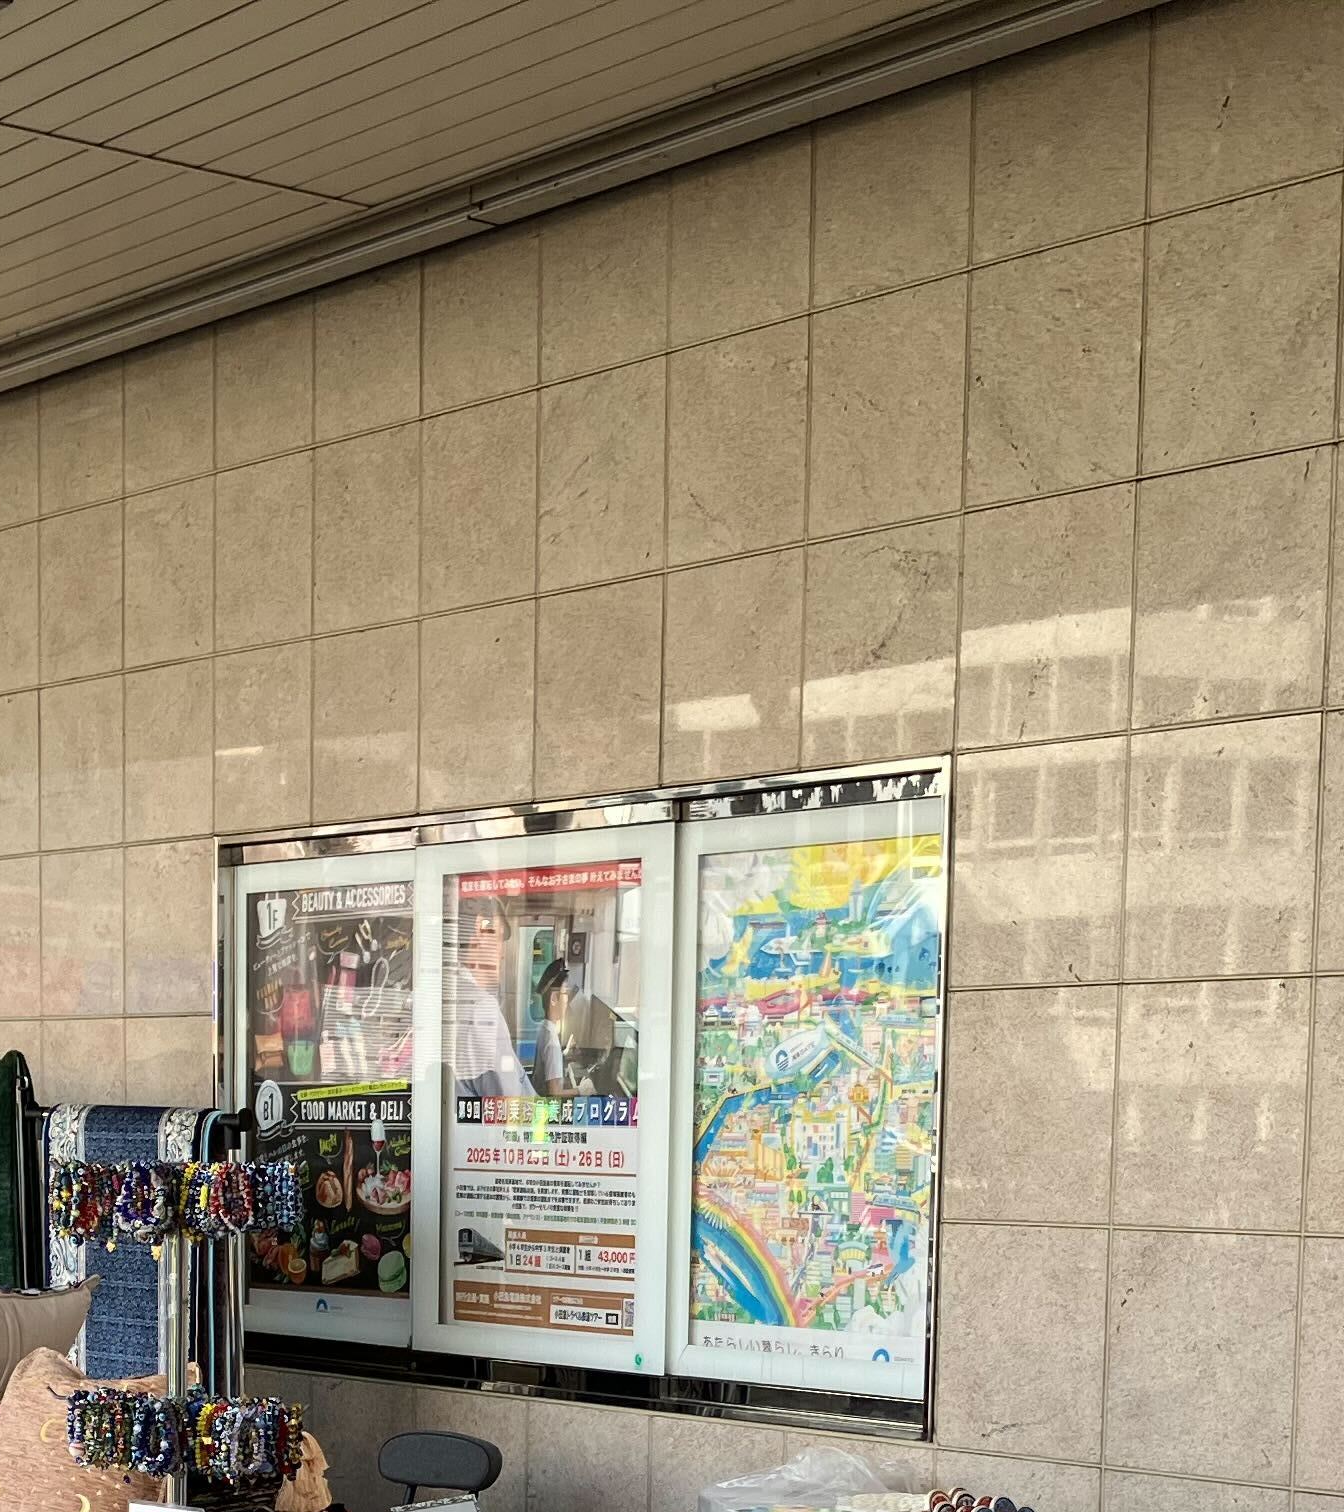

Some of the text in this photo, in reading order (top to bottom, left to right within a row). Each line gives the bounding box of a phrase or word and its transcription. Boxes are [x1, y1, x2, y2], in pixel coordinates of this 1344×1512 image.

[301, 884, 406, 913] BEAUTY & ACCESSORIES
[301, 1100, 404, 1121] FOOD MARKET & DELI
[458, 1100, 481, 1120] 第9回
